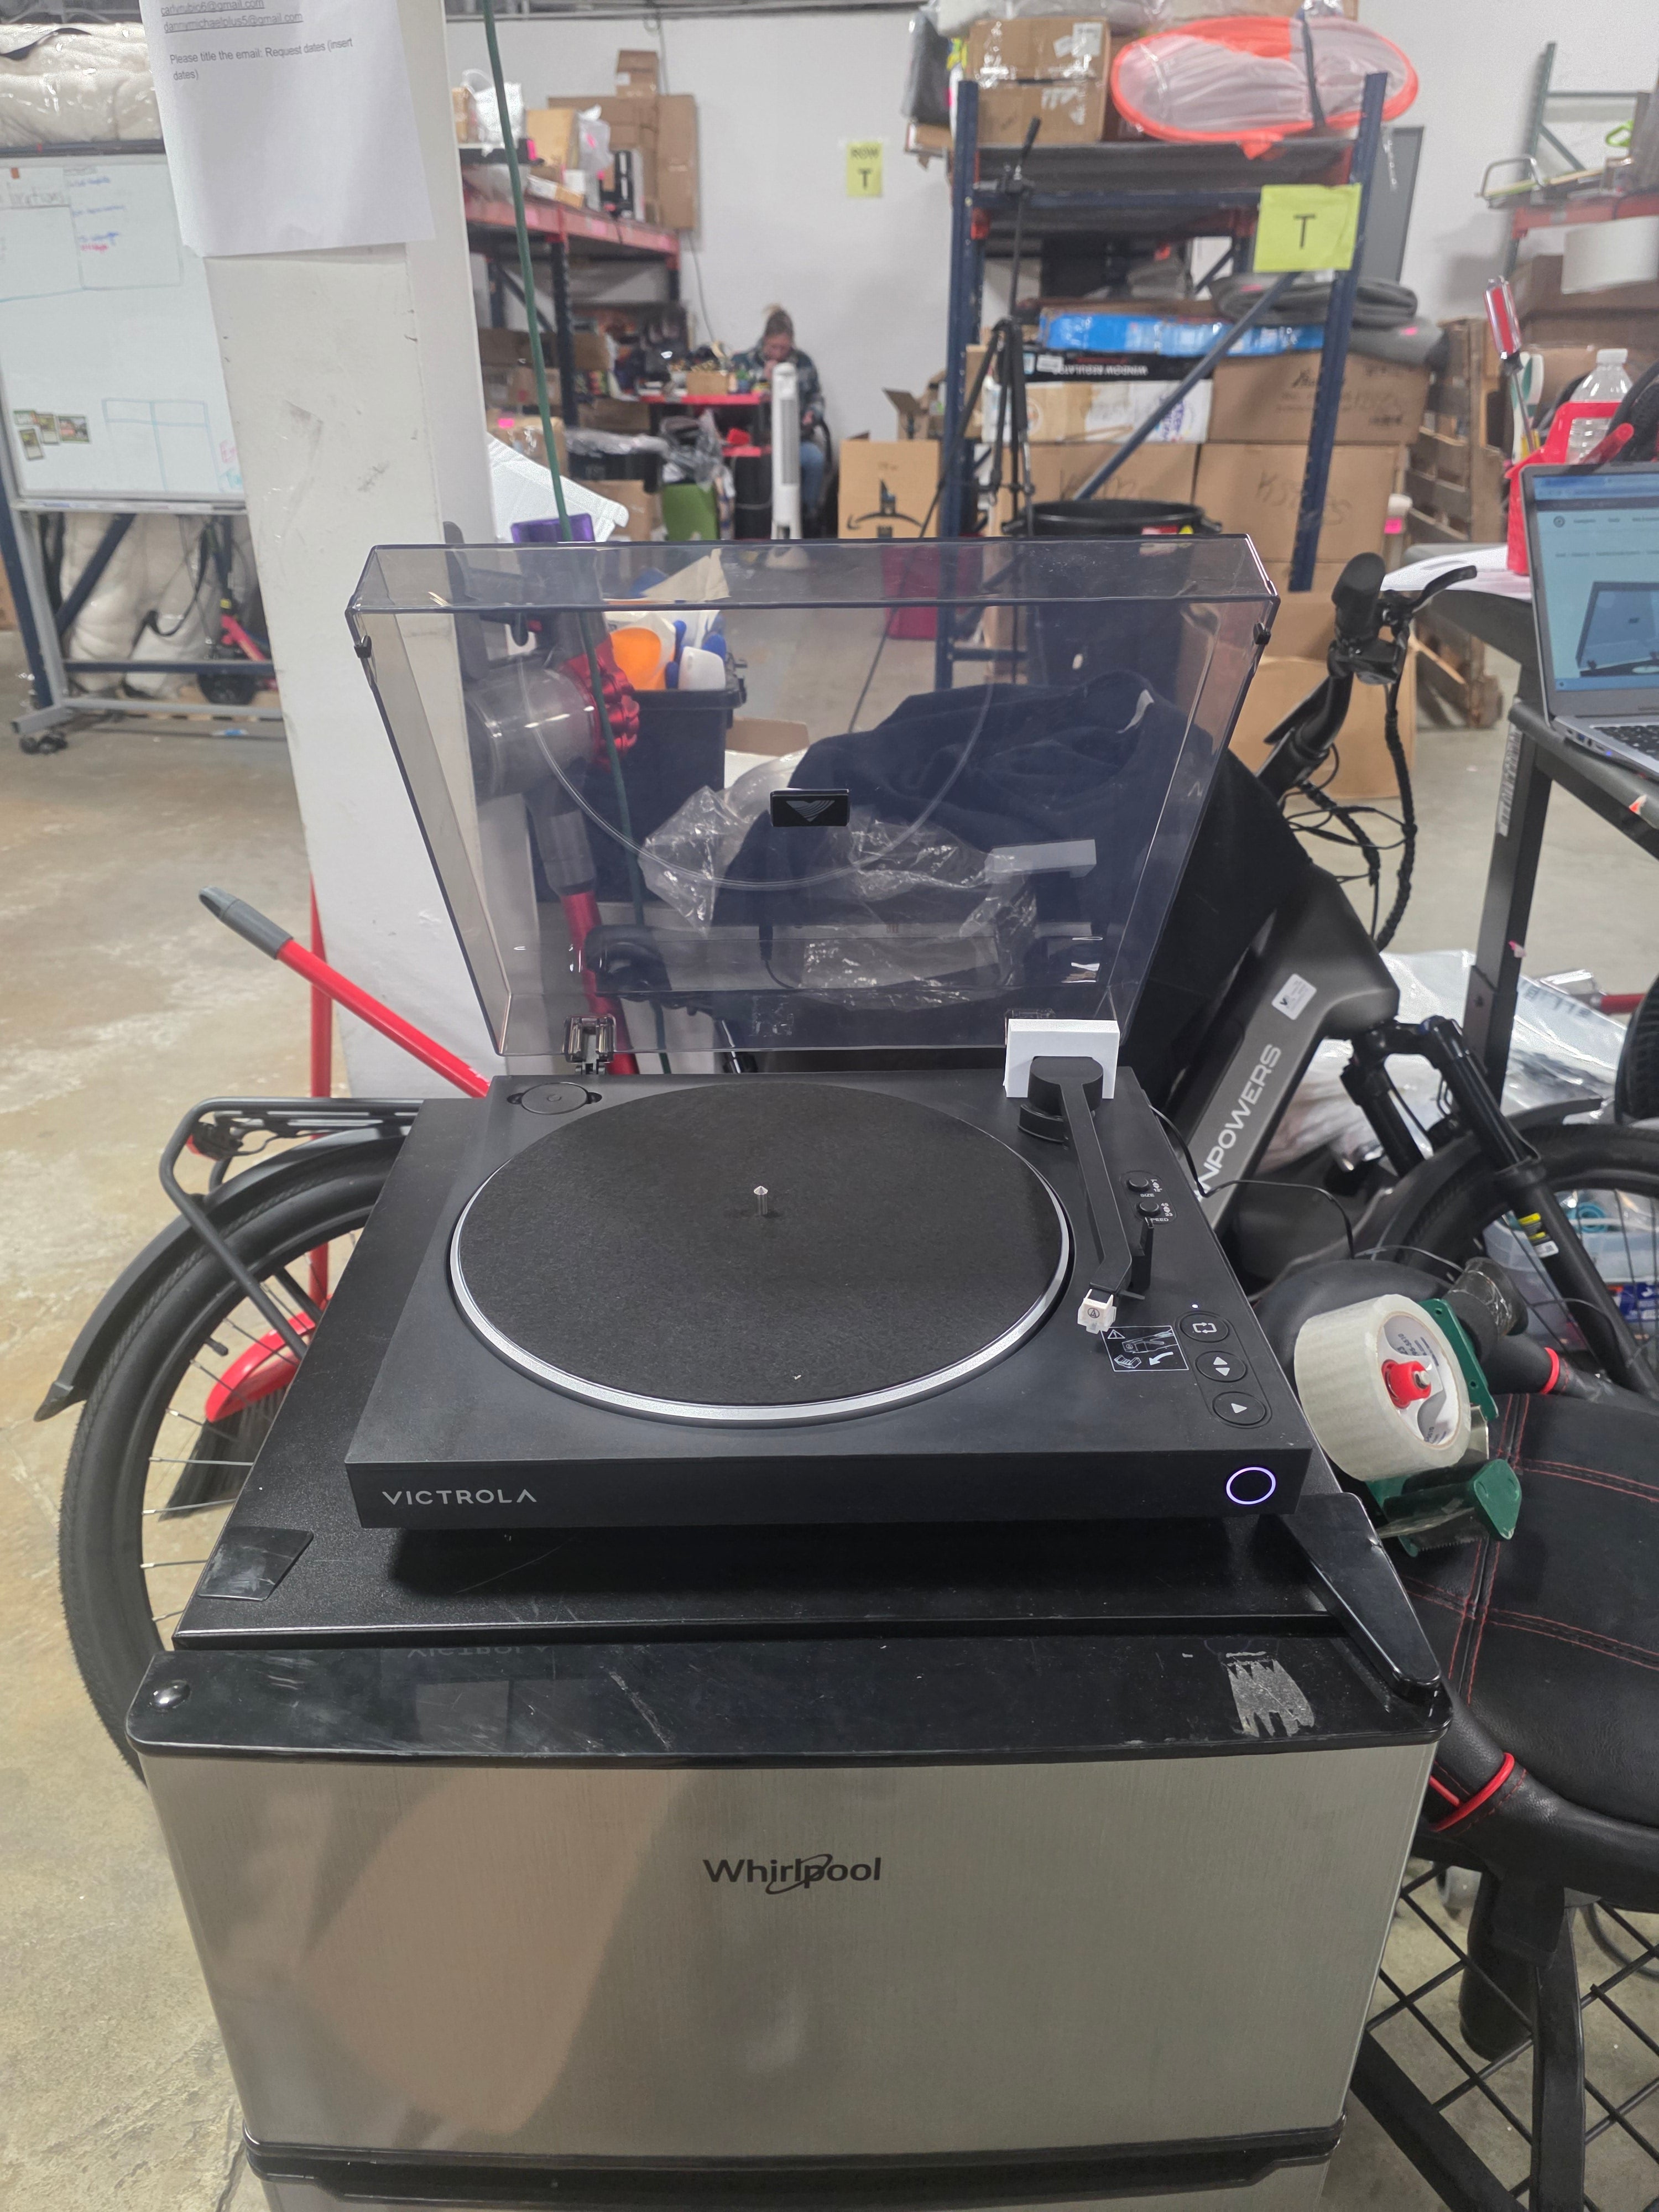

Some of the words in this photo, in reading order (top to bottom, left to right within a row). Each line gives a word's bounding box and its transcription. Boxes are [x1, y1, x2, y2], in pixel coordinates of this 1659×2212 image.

[170, 54, 198, 64] Please
[200, 51, 216, 61] title
[218, 51, 233, 60] the
[236, 48, 263, 59] email:
[265, 45, 302, 58] Request
[304, 43, 326, 53] dates
[327, 38, 353, 52] (insert
[173, 69, 199, 81] dates)
[851, 147, 879, 159] ROW
[857, 168, 872, 190] T
[1293, 213, 1317, 250] T
[382, 1489, 537, 1505] VICTROLA
[703, 1854, 881, 1894] Whirlpool
